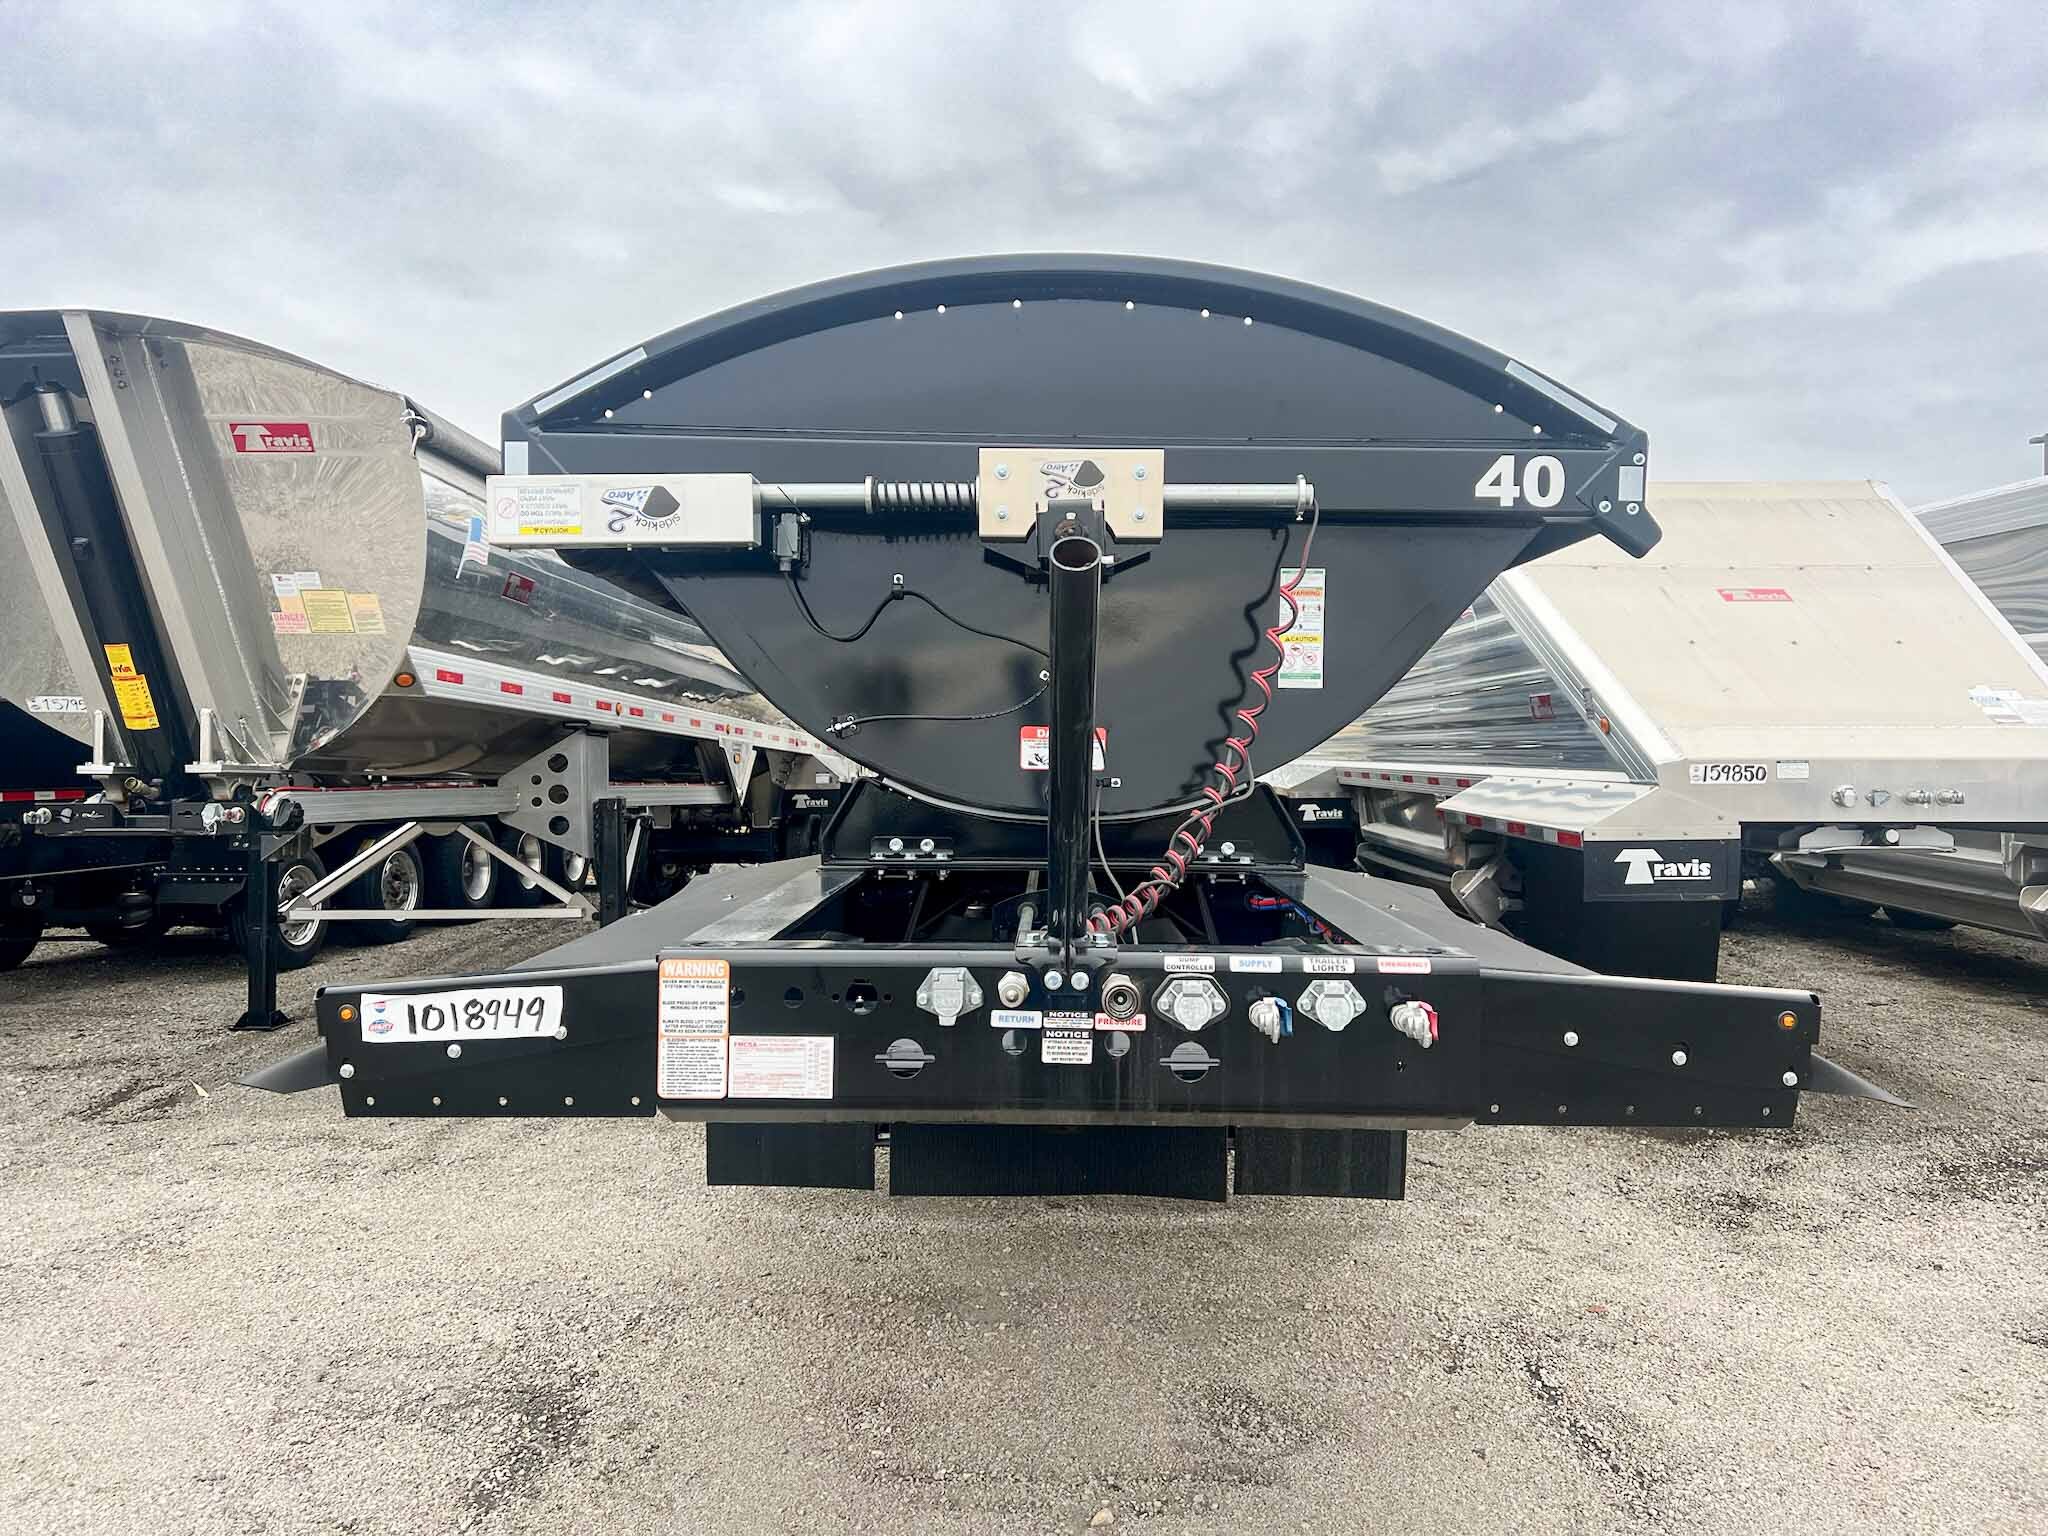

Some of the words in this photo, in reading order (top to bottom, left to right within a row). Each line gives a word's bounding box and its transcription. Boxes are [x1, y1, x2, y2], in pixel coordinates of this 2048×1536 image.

[233, 425, 312, 450] Travis
[1045, 479, 1066, 498] 2
[1475, 455, 1566, 508] 40
[608, 490, 636, 501] Aero
[608, 509, 633, 533] 2
[634, 513, 681, 532] sidekick
[1703, 764, 1768, 782] 159850
[791, 794, 829, 809] Travis
[1298, 804, 1343, 821] Travis
[1614, 849, 1711, 885] Travis
[663, 962, 725, 977] WARNING
[1166, 963, 1214, 971] CONTROLLER
[1239, 959, 1273, 968] SUPPLY
[1312, 964, 1347, 972] LIGHTS
[407, 996, 545, 1035] 1018949
[998, 1015, 1035, 1023] RETURN
[1045, 1031, 1090, 1039] NOTICE
